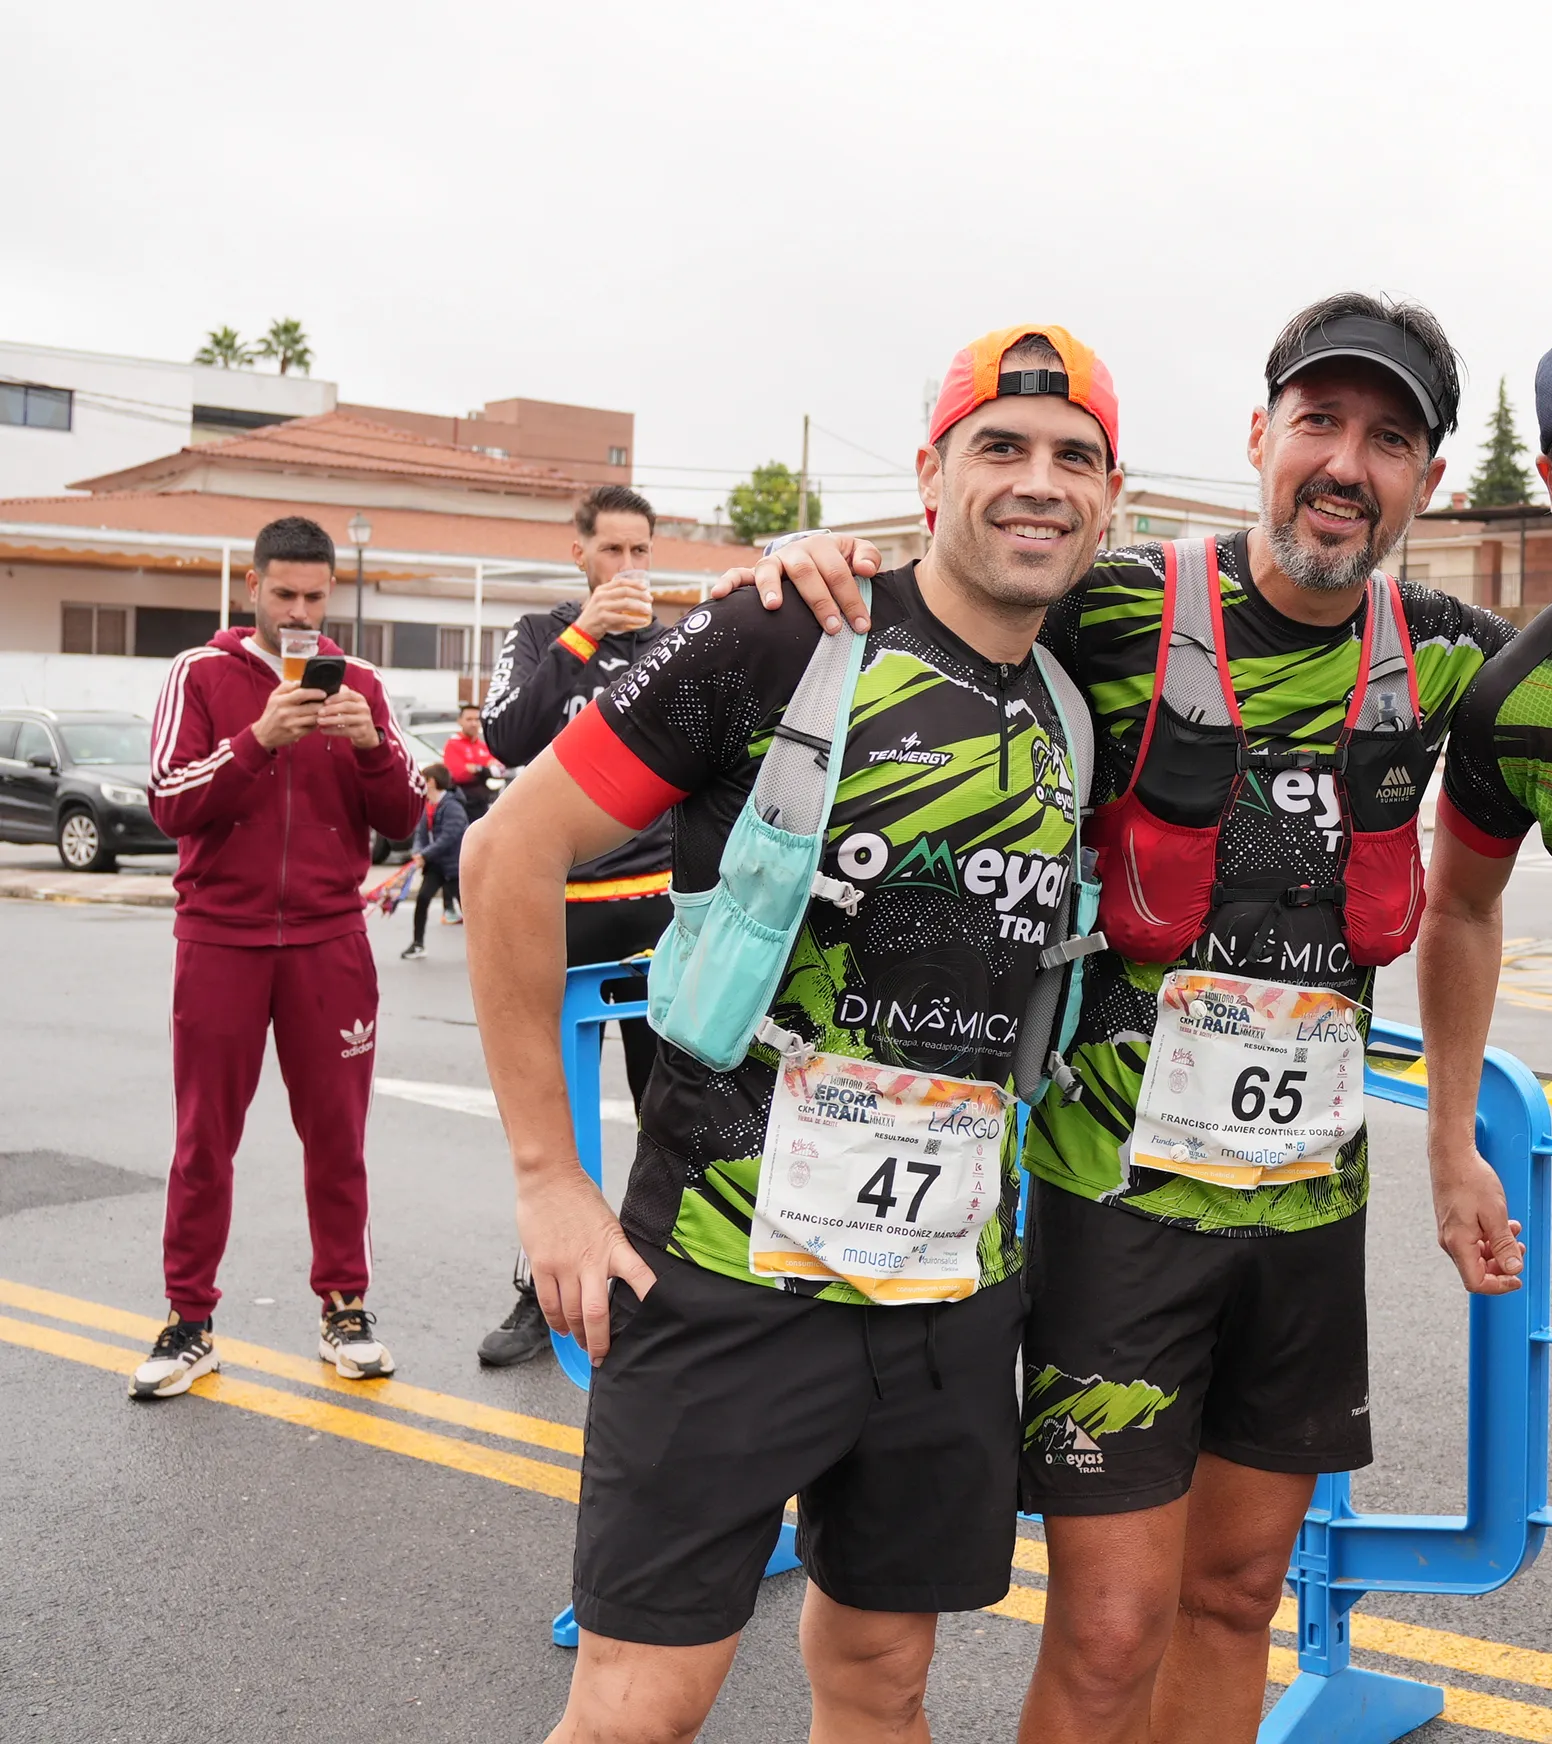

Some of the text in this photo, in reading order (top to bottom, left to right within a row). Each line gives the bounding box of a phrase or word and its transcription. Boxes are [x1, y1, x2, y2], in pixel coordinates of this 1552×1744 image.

[614, 633, 687, 714] KELSEN
[868, 749, 953, 767] TEAMERGY
[1380, 795, 1410, 804] RUNNING
[837, 832, 1070, 912] oMeya
[1000, 914, 1050, 945] TRA
[1204, 991, 1235, 1004] MONTORO
[1179, 1016, 1194, 1026] CXM
[1199, 999, 1250, 1023] PORA
[1296, 1021, 1357, 1043] LARGO
[341, 1040, 374, 1059] adidas
[1243, 1042, 1288, 1054] RESULTADOS
[814, 1083, 878, 1110] EPORA
[1231, 1065, 1308, 1125] 65
[797, 1104, 815, 1114] CXM
[816, 1101, 870, 1125] TRAIL
[1160, 1112, 1219, 1131] FRANCISCO
[1221, 1124, 1256, 1135] JAVIER
[1308, 1128, 1346, 1138] DORADO
[874, 1131, 920, 1144] RESULTADOS
[928, 1111, 1000, 1140] LARGO
[857, 1156, 942, 1223] 47
[779, 1209, 844, 1228] FRANCISCO
[846, 1220, 884, 1233] JAVIER
[886, 1225, 933, 1239] ORDÓÑEZ
[1078, 1466, 1106, 1474] TRAIL
